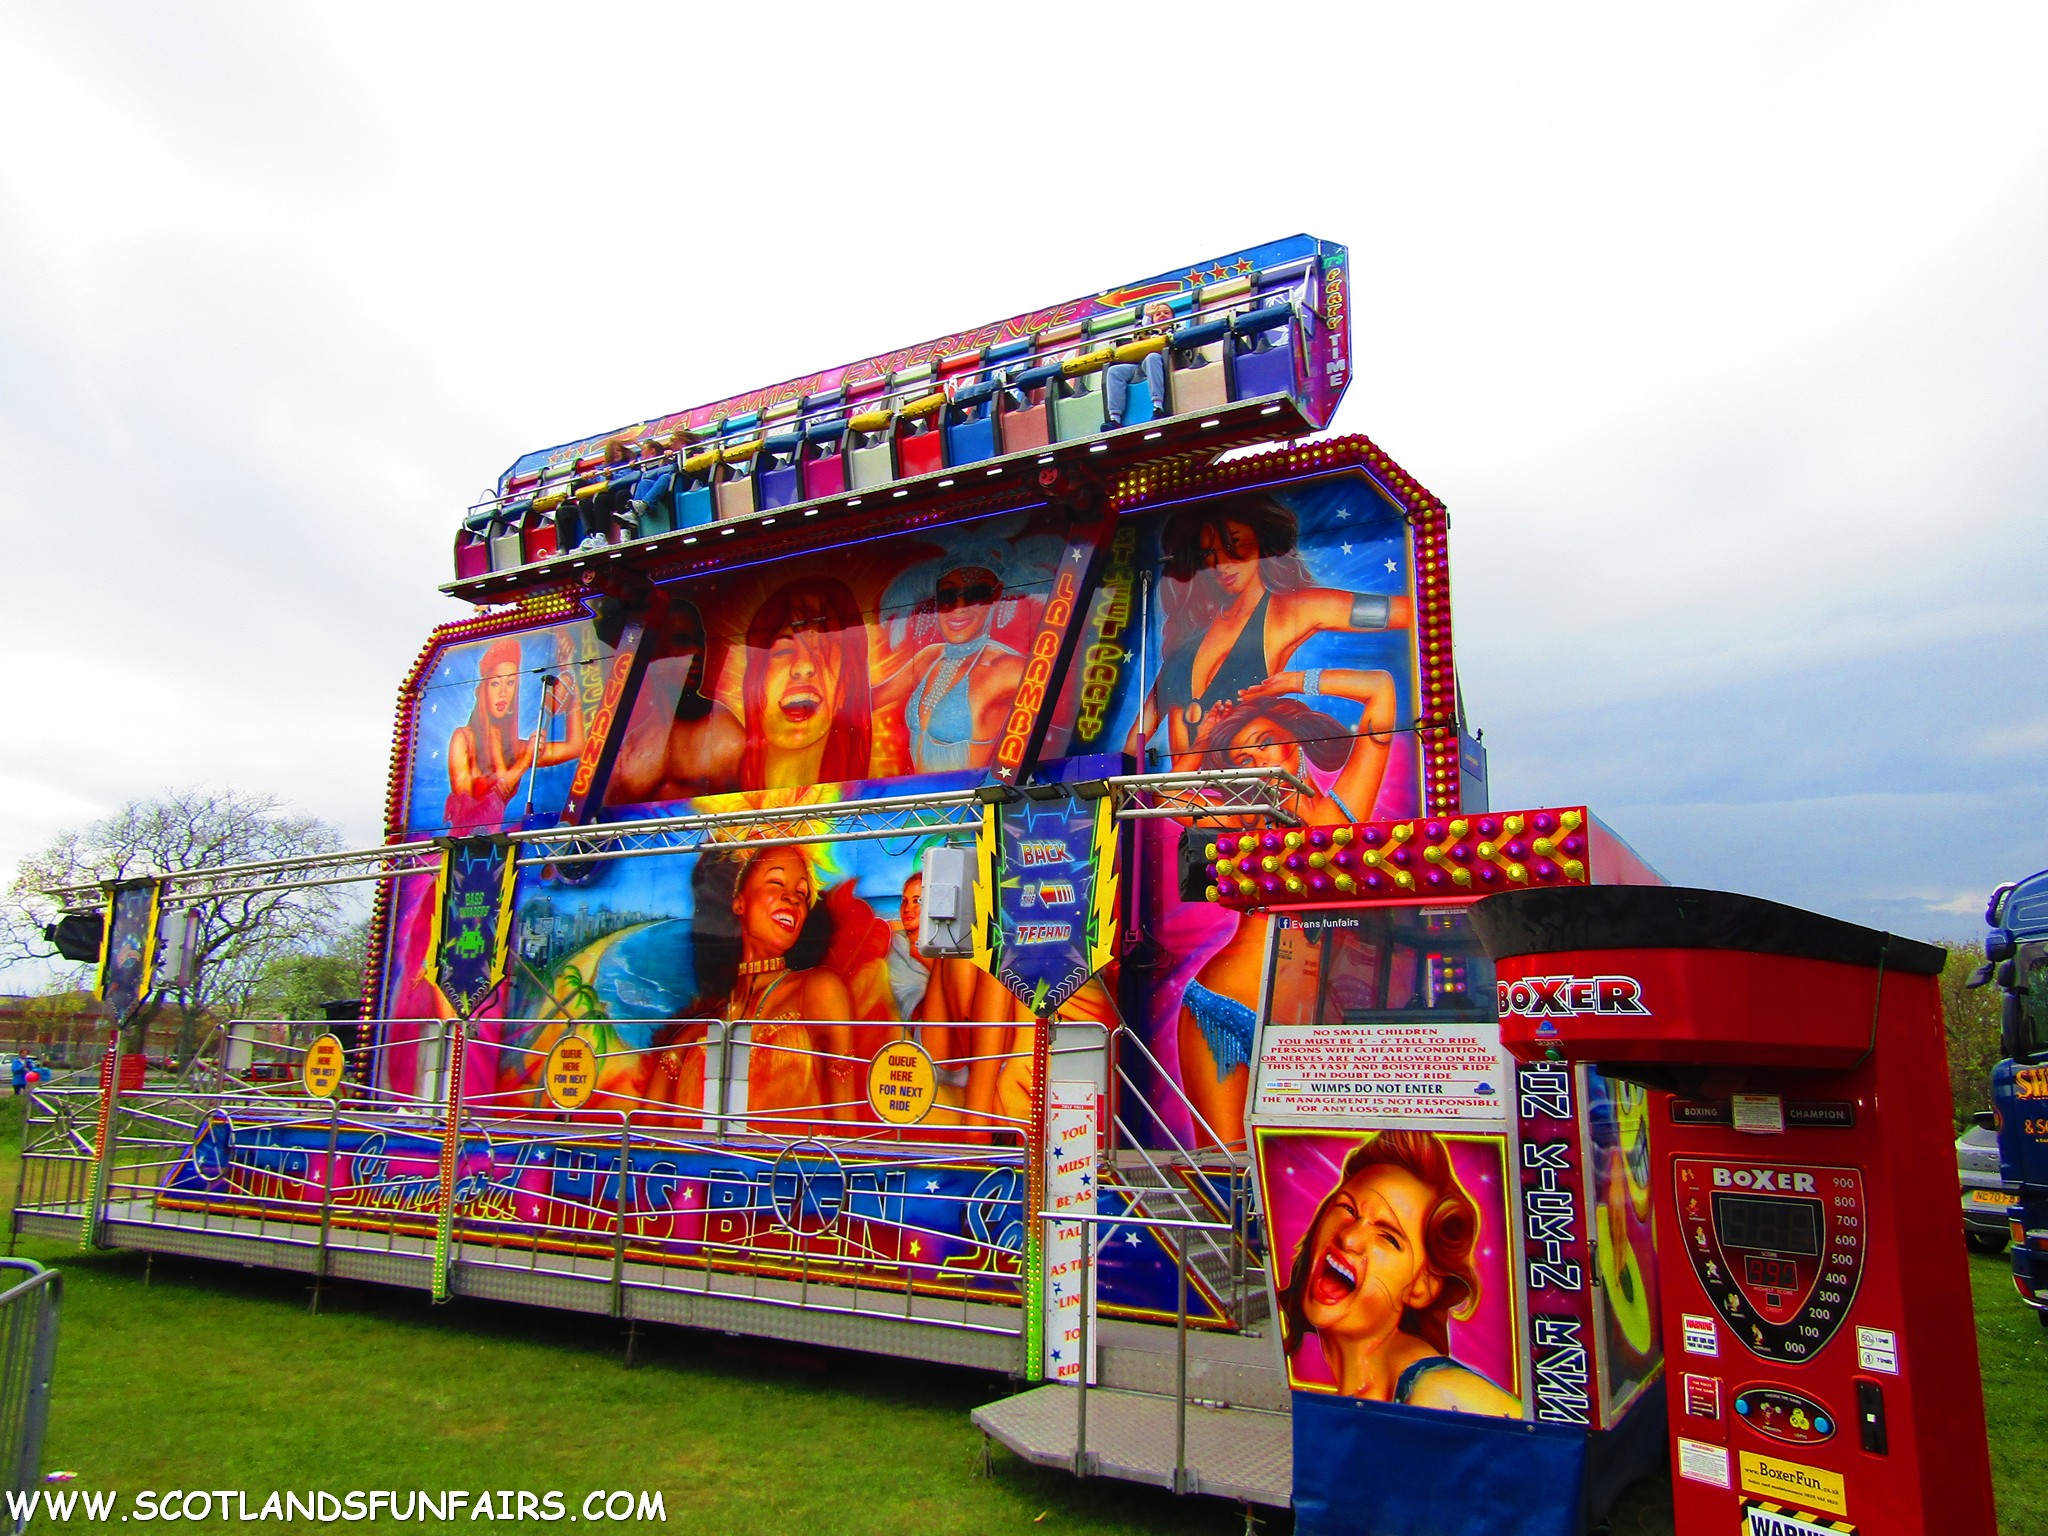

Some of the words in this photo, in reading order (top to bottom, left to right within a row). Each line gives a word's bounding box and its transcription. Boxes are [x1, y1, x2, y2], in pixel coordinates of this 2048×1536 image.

[1325, 267, 1344, 331] PARTY
[1326, 333, 1346, 387] TIME
[654, 411, 693, 437] LA
[709, 373, 823, 423] BAMBA
[840, 300, 1083, 387] EXPERIENCE
[1093, 527, 1136, 639] STREET
[1045, 572, 1075, 627] LA
[997, 630, 1060, 764] BAMBA
[1077, 643, 1124, 740] PARTY
[1019, 841, 1076, 868] BACK
[465, 892, 486, 906] BASS
[1021, 894, 1037, 907] THE
[1291, 920, 1321, 929] Evans
[1323, 917, 1360, 928] funfairs
[1015, 923, 1072, 945] TECHNO
[1497, 975, 1653, 1018] BOXER
[1377, 1028, 1438, 1036] CHILDREN
[561, 1049, 583, 1059] QUEUE
[562, 1061, 581, 1071] HERE
[888, 1055, 917, 1068] QUEUE
[553, 1073, 567, 1084] FOR
[569, 1074, 588, 1084] NEXT
[889, 1070, 913, 1082] HERE
[1311, 1083, 1351, 1093] WIMPS
[1354, 1083, 1373, 1093] DO
[1376, 1083, 1401, 1093] NOT
[1405, 1084, 1443, 1094] ENTER
[2014, 1068, 2048, 1100] SH
[562, 1087, 579, 1097] RIDE
[879, 1084, 897, 1096] FOR
[899, 1086, 923, 1098] NEXT
[889, 1099, 911, 1112] RIDE
[1416, 1099, 1500, 1107] RESPONSIBLE
[1404, 1107, 1460, 1115] DAMAGE
[1684, 1107, 1718, 1117] BOXING
[1789, 1109, 1845, 1120] CHAMPION
[1061, 1124, 1088, 1141] YOU
[2024, 1119, 2035, 1135] &
[1056, 1156, 1092, 1177] MUST
[1712, 1167, 1816, 1193] BOXER
[1833, 1177, 1854, 1189] 900
[1056, 1196, 1072, 1209] BE
[1075, 1188, 1093, 1203] AS
[1834, 1196, 1856, 1208] 800
[547, 1147, 677, 1245] HAS
[702, 1169, 906, 1270] BEEN
[937, 1166, 1024, 1278] Se
[1523, 1143, 1581, 1291] KICKIN
[1836, 1215, 1858, 1227] 700
[1058, 1226, 1082, 1241] TAL
[1835, 1235, 1857, 1247] 600
[1831, 1254, 1853, 1266] 500
[1051, 1262, 1068, 1277] AS
[1825, 1273, 1847, 1285] 400
[1058, 1293, 1082, 1310] LIN
[1819, 1291, 1841, 1303] 300
[1808, 1307, 1830, 1320] 200
[1064, 1327, 1082, 1342] TO
[1799, 1325, 1820, 1338] 100
[1784, 1341, 1806, 1354] 000
[1057, 1362, 1081, 1379] RID
